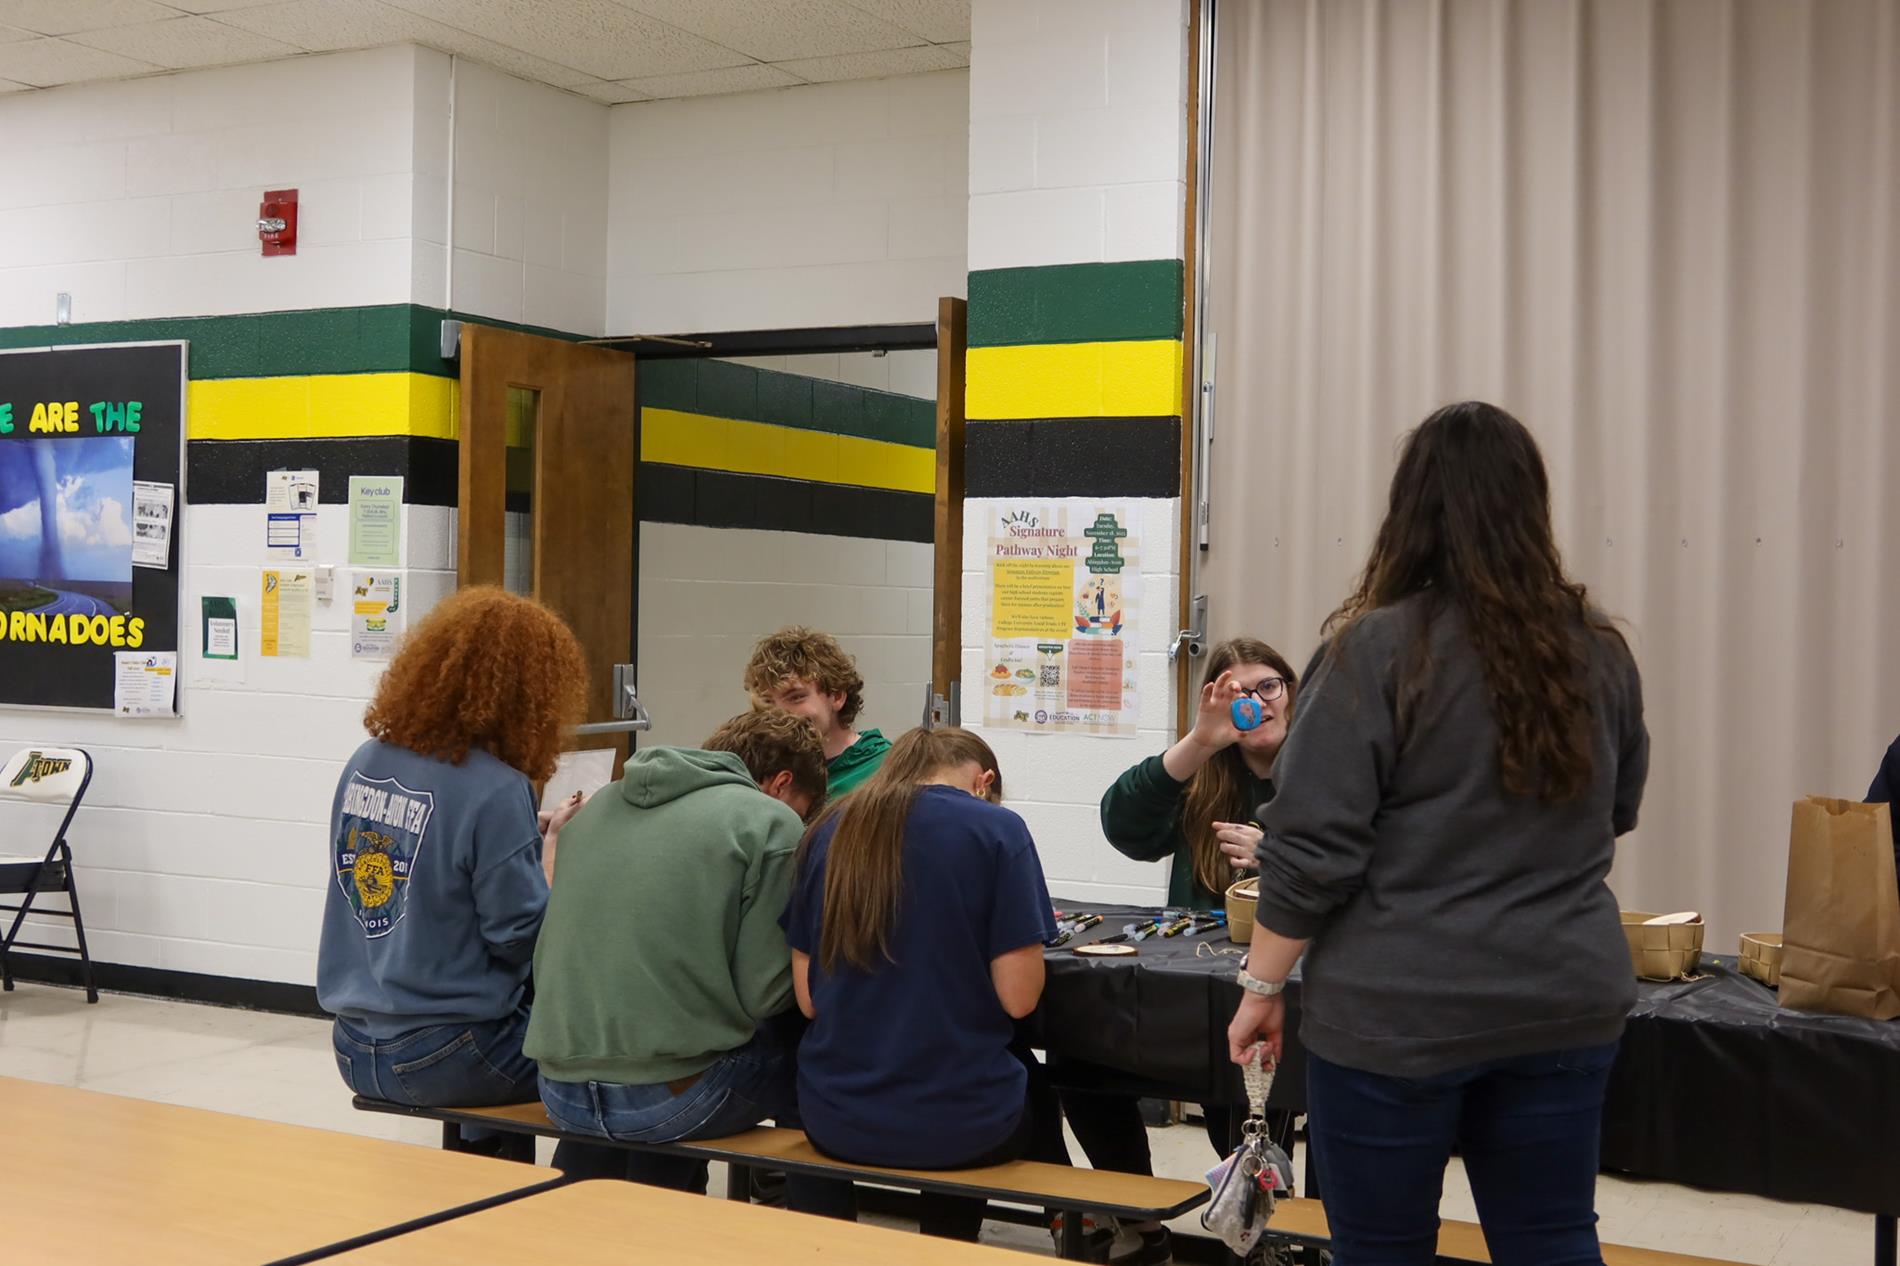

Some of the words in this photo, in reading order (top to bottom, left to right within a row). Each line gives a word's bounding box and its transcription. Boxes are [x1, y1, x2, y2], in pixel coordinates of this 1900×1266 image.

[29, 402, 79, 433] ARE
[89, 401, 142, 433] THE
[361, 487, 374, 497] Key
[375, 487, 391, 496] club
[1001, 511, 1039, 528] AAHS
[1010, 525, 1065, 539] Signature
[996, 544, 1043, 558] Pathway
[1047, 545, 1078, 558] Night
[0, 610, 144, 648] RNADOES
[405, 799, 427, 834] FFA
[366, 864, 384, 876] FFA
